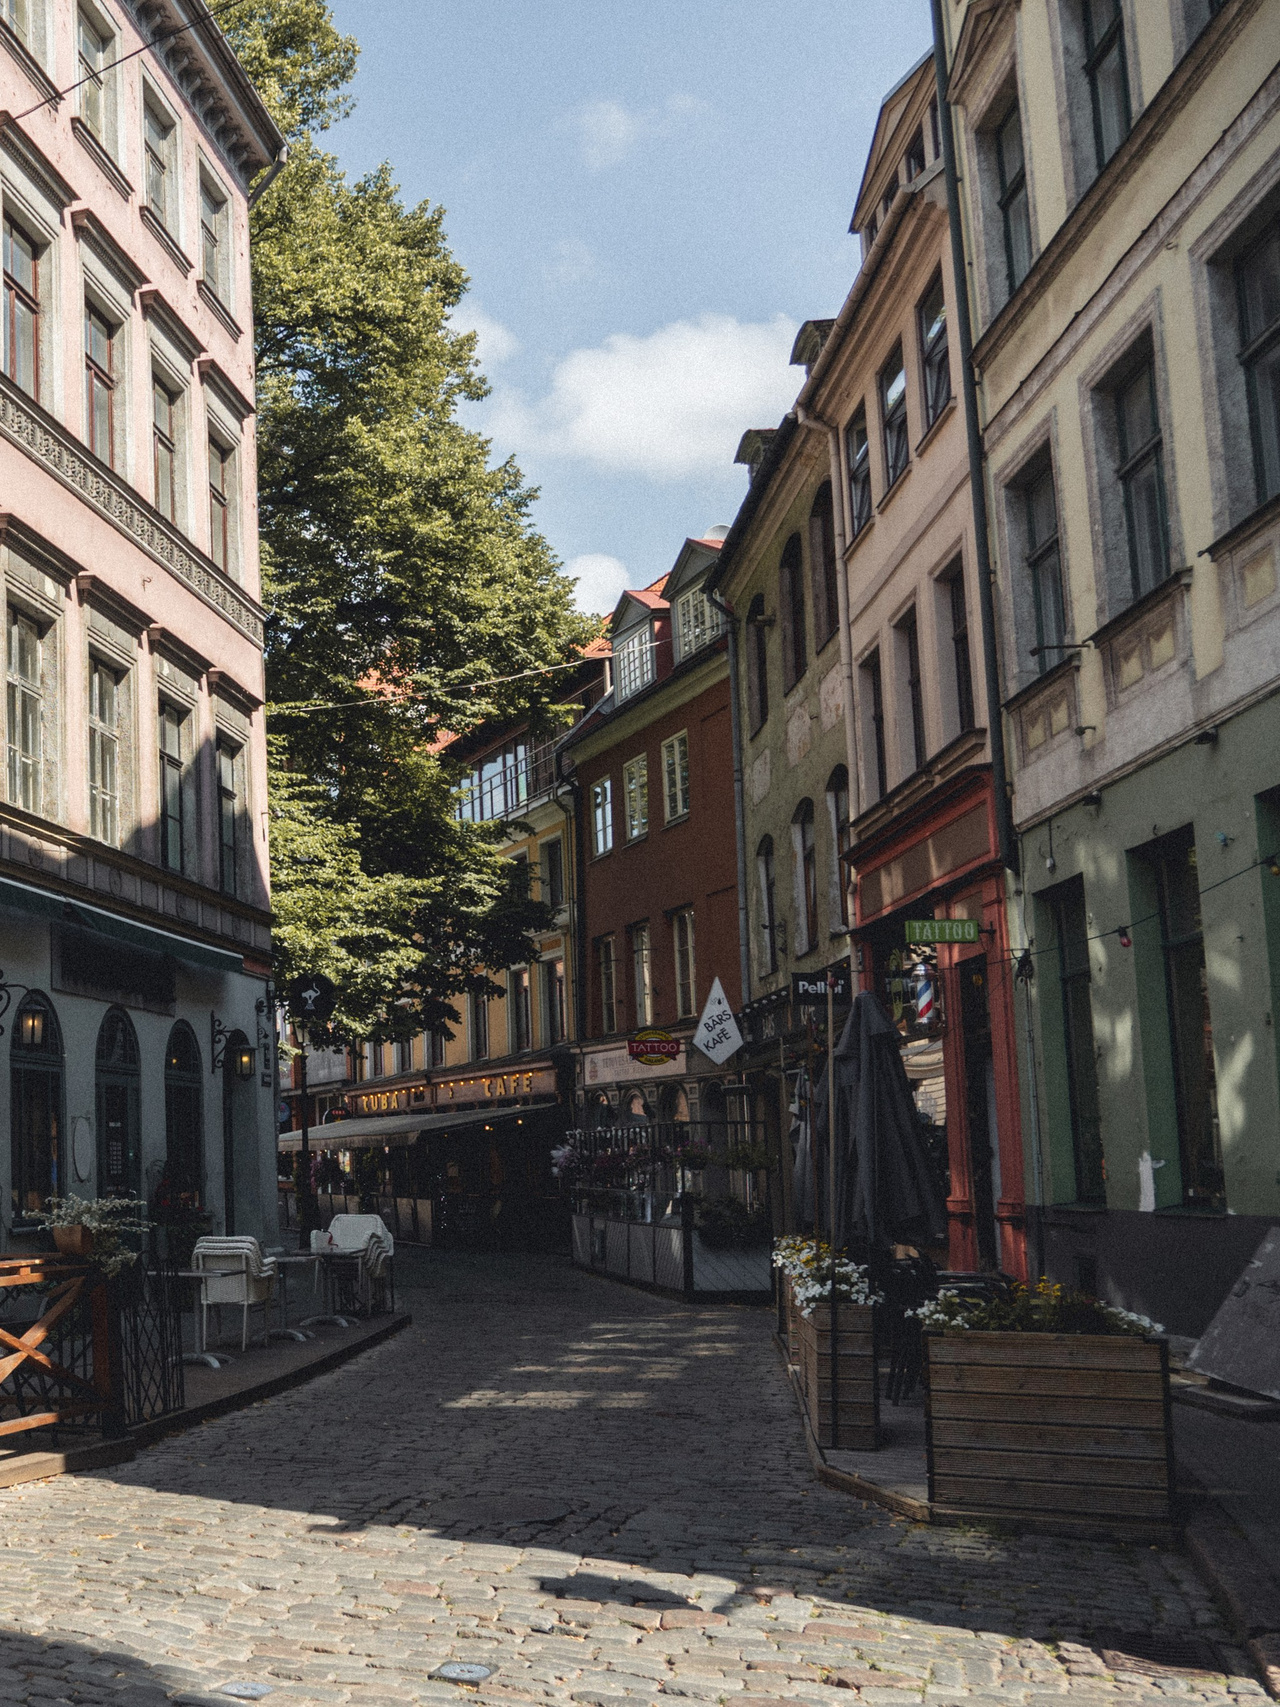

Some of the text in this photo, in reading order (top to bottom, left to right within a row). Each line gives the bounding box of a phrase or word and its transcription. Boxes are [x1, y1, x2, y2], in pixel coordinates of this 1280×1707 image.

[913, 922, 975, 940] TATTOO
[703, 1009, 732, 1033] BĀRS
[631, 1042, 677, 1052] TATTOO
[703, 1027, 732, 1052] KAFĒ
[362, 1094, 399, 1112] CUBA
